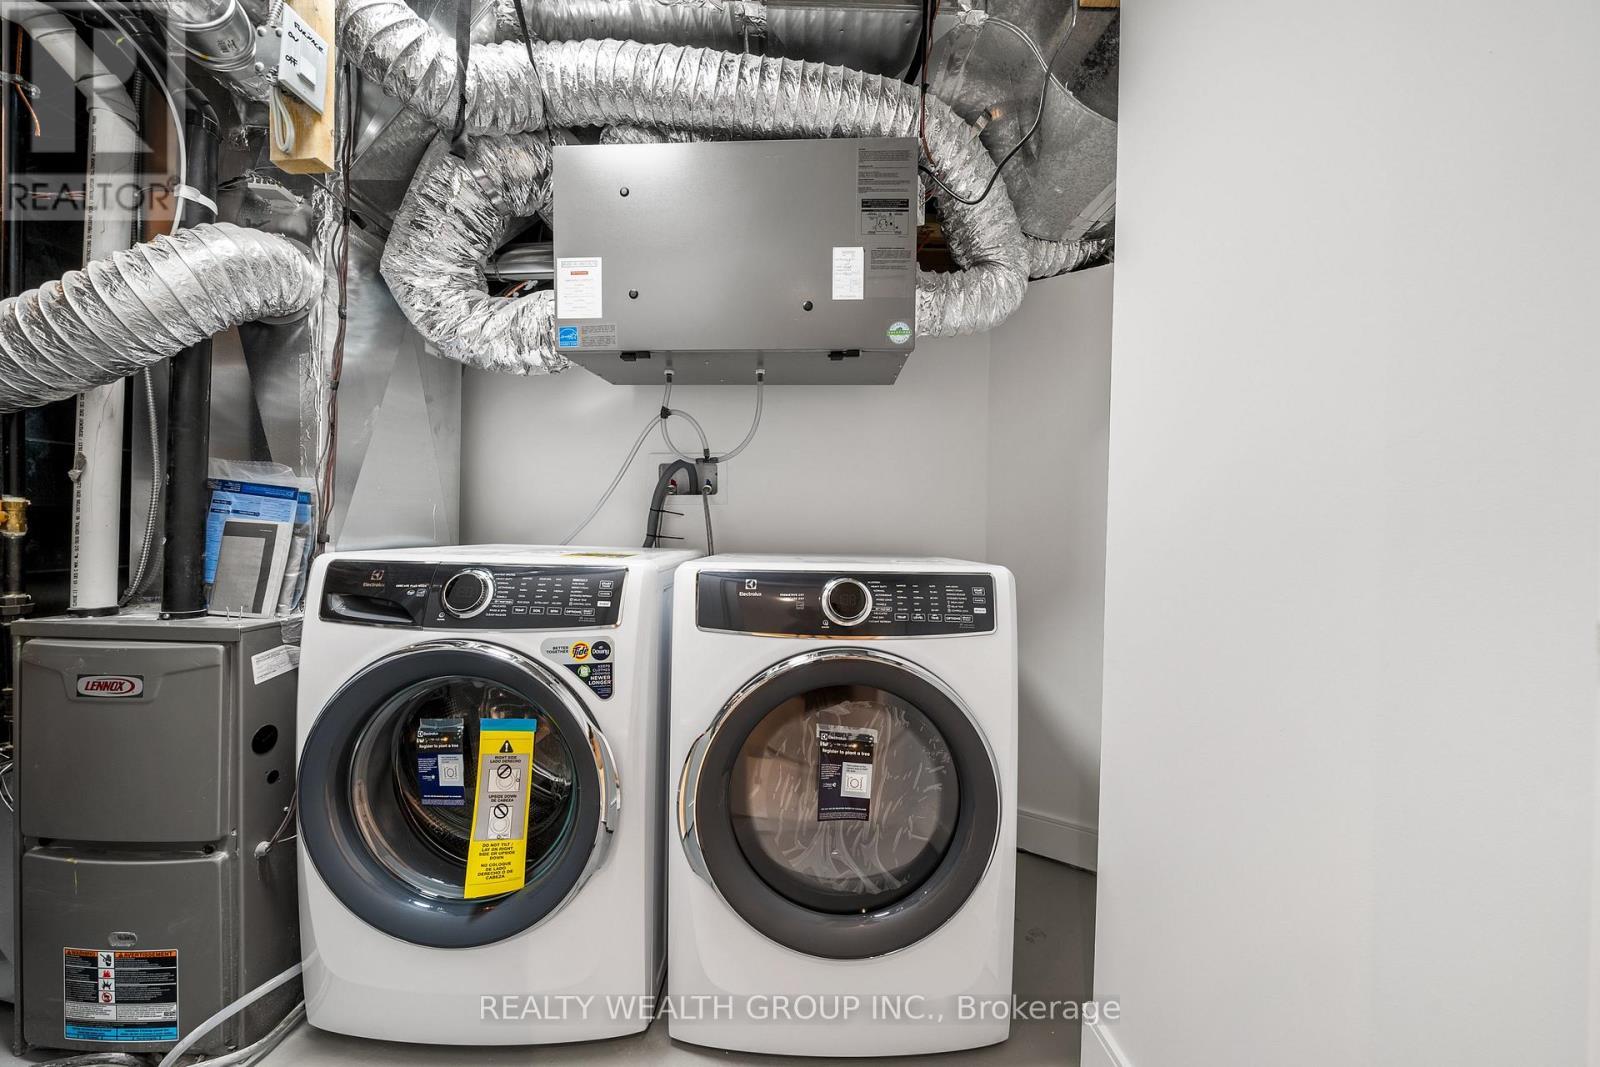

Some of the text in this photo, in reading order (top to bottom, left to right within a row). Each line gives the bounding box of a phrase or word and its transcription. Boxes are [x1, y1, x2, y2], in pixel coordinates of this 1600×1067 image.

[293, 21, 325, 55] FURNACE
[285, 54, 298, 67] OFF
[572, 644, 589, 658] Tide
[592, 648, 611, 656] Downy
[84, 680, 126, 692] LENNOX
